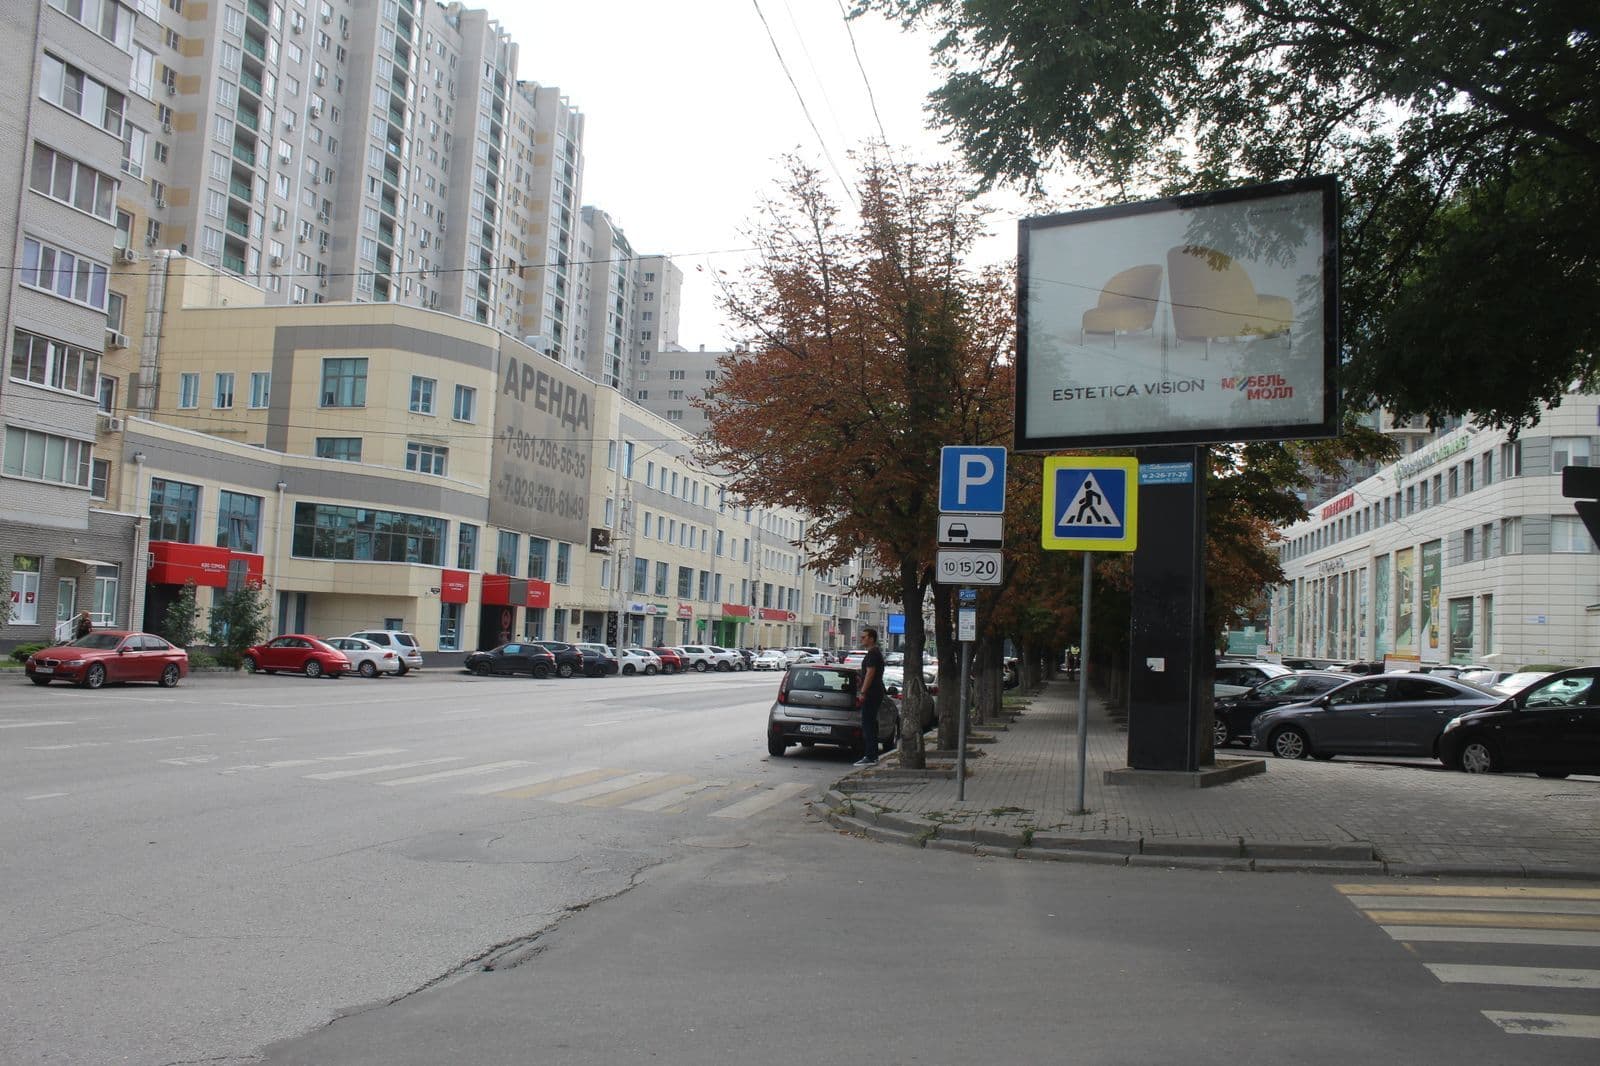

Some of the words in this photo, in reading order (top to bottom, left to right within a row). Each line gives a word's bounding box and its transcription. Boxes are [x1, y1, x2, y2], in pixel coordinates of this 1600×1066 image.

[503, 357, 589, 432] АРЕНДА
[1052, 384, 1139, 401] ESTETICA
[1144, 379, 1205, 395] VISION
[1247, 386, 1293, 400] МОЛЛ
[957, 454, 995, 505] P
[944, 562, 956, 572] 10
[960, 561, 972, 572] 15
[975, 560, 996, 575] 20
